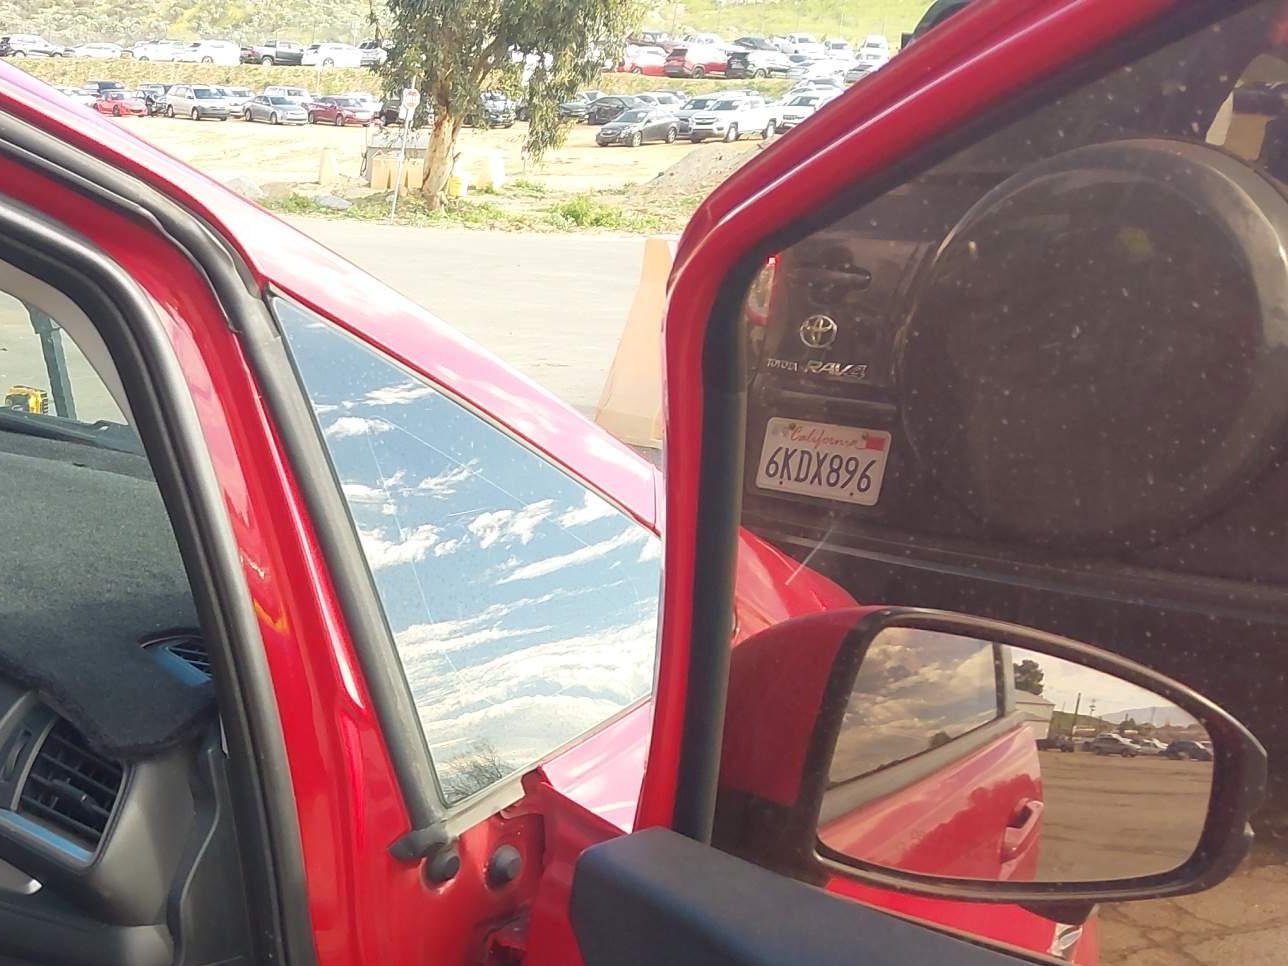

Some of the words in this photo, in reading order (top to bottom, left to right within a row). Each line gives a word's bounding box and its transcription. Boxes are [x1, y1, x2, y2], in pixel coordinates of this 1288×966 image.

[804, 359, 869, 380] RAV4
[790, 425, 859, 449] California
[765, 446, 877, 493] 6KDX896
